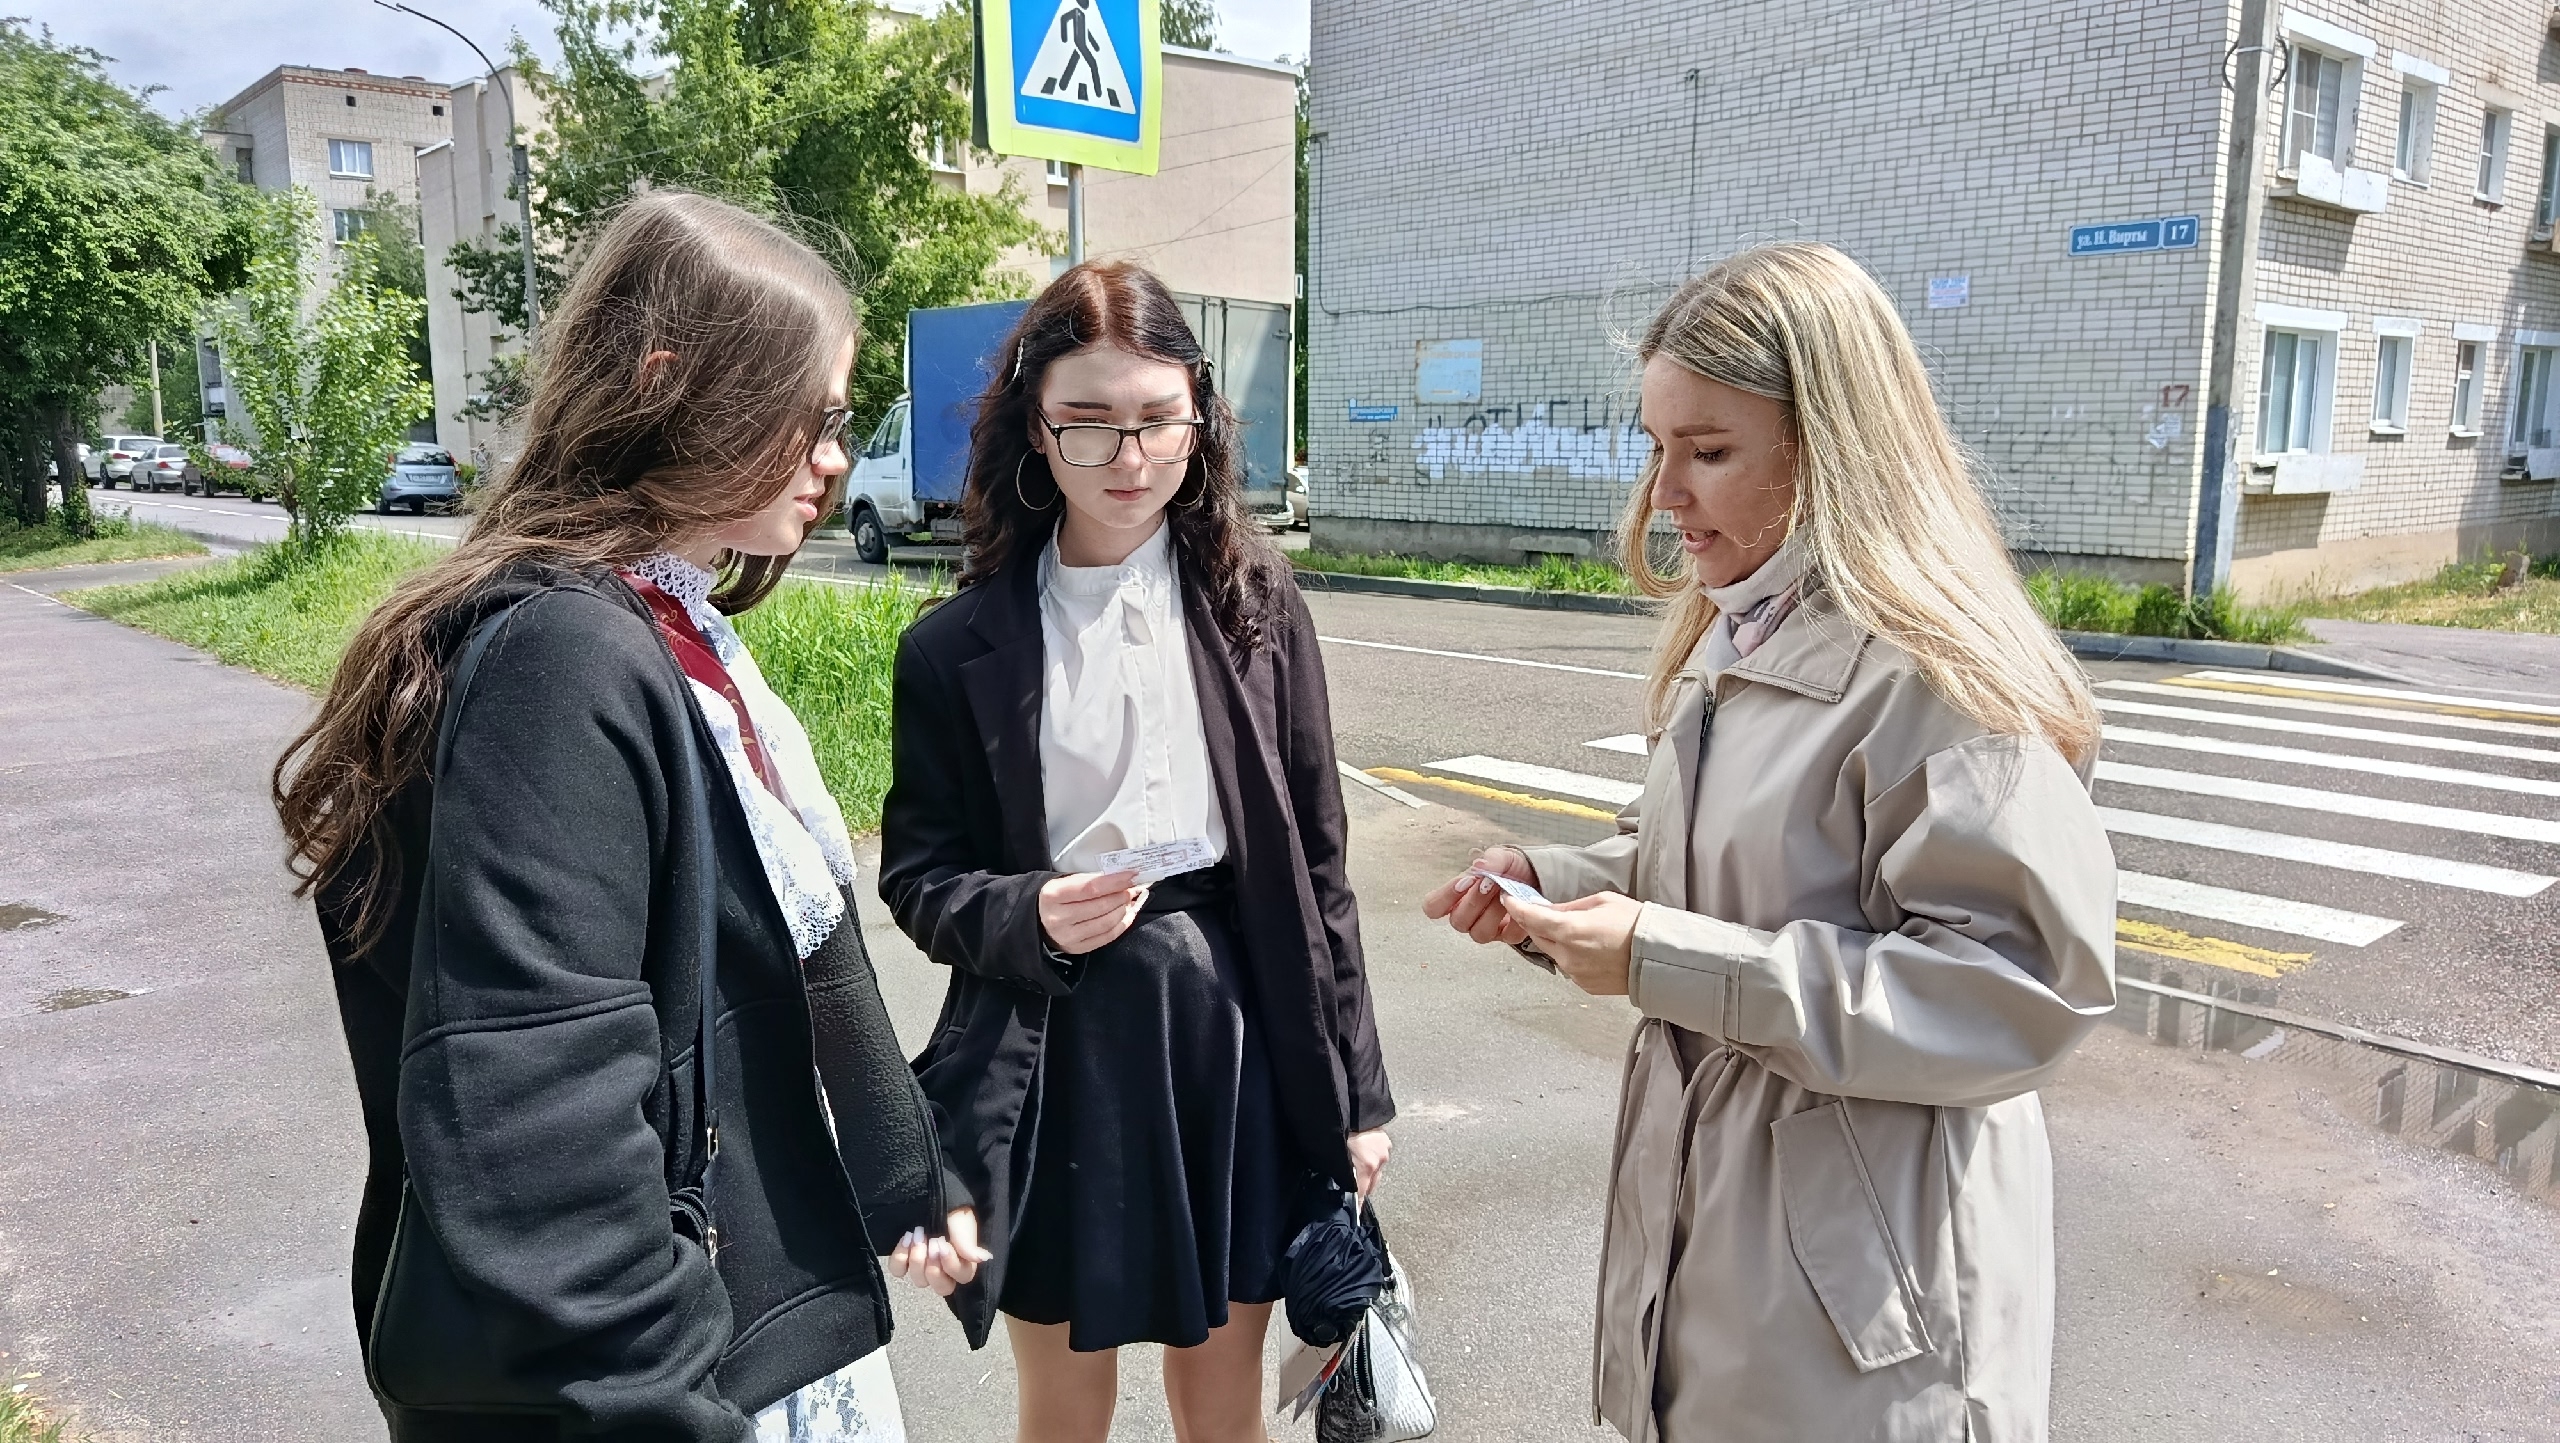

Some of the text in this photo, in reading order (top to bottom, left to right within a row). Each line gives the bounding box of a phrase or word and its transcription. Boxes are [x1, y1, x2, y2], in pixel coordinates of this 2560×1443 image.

[2077, 229, 2148, 249] ул. Н. Вирты
[2171, 224, 2189, 240] 17
[2161, 384, 2190, 408] 17
